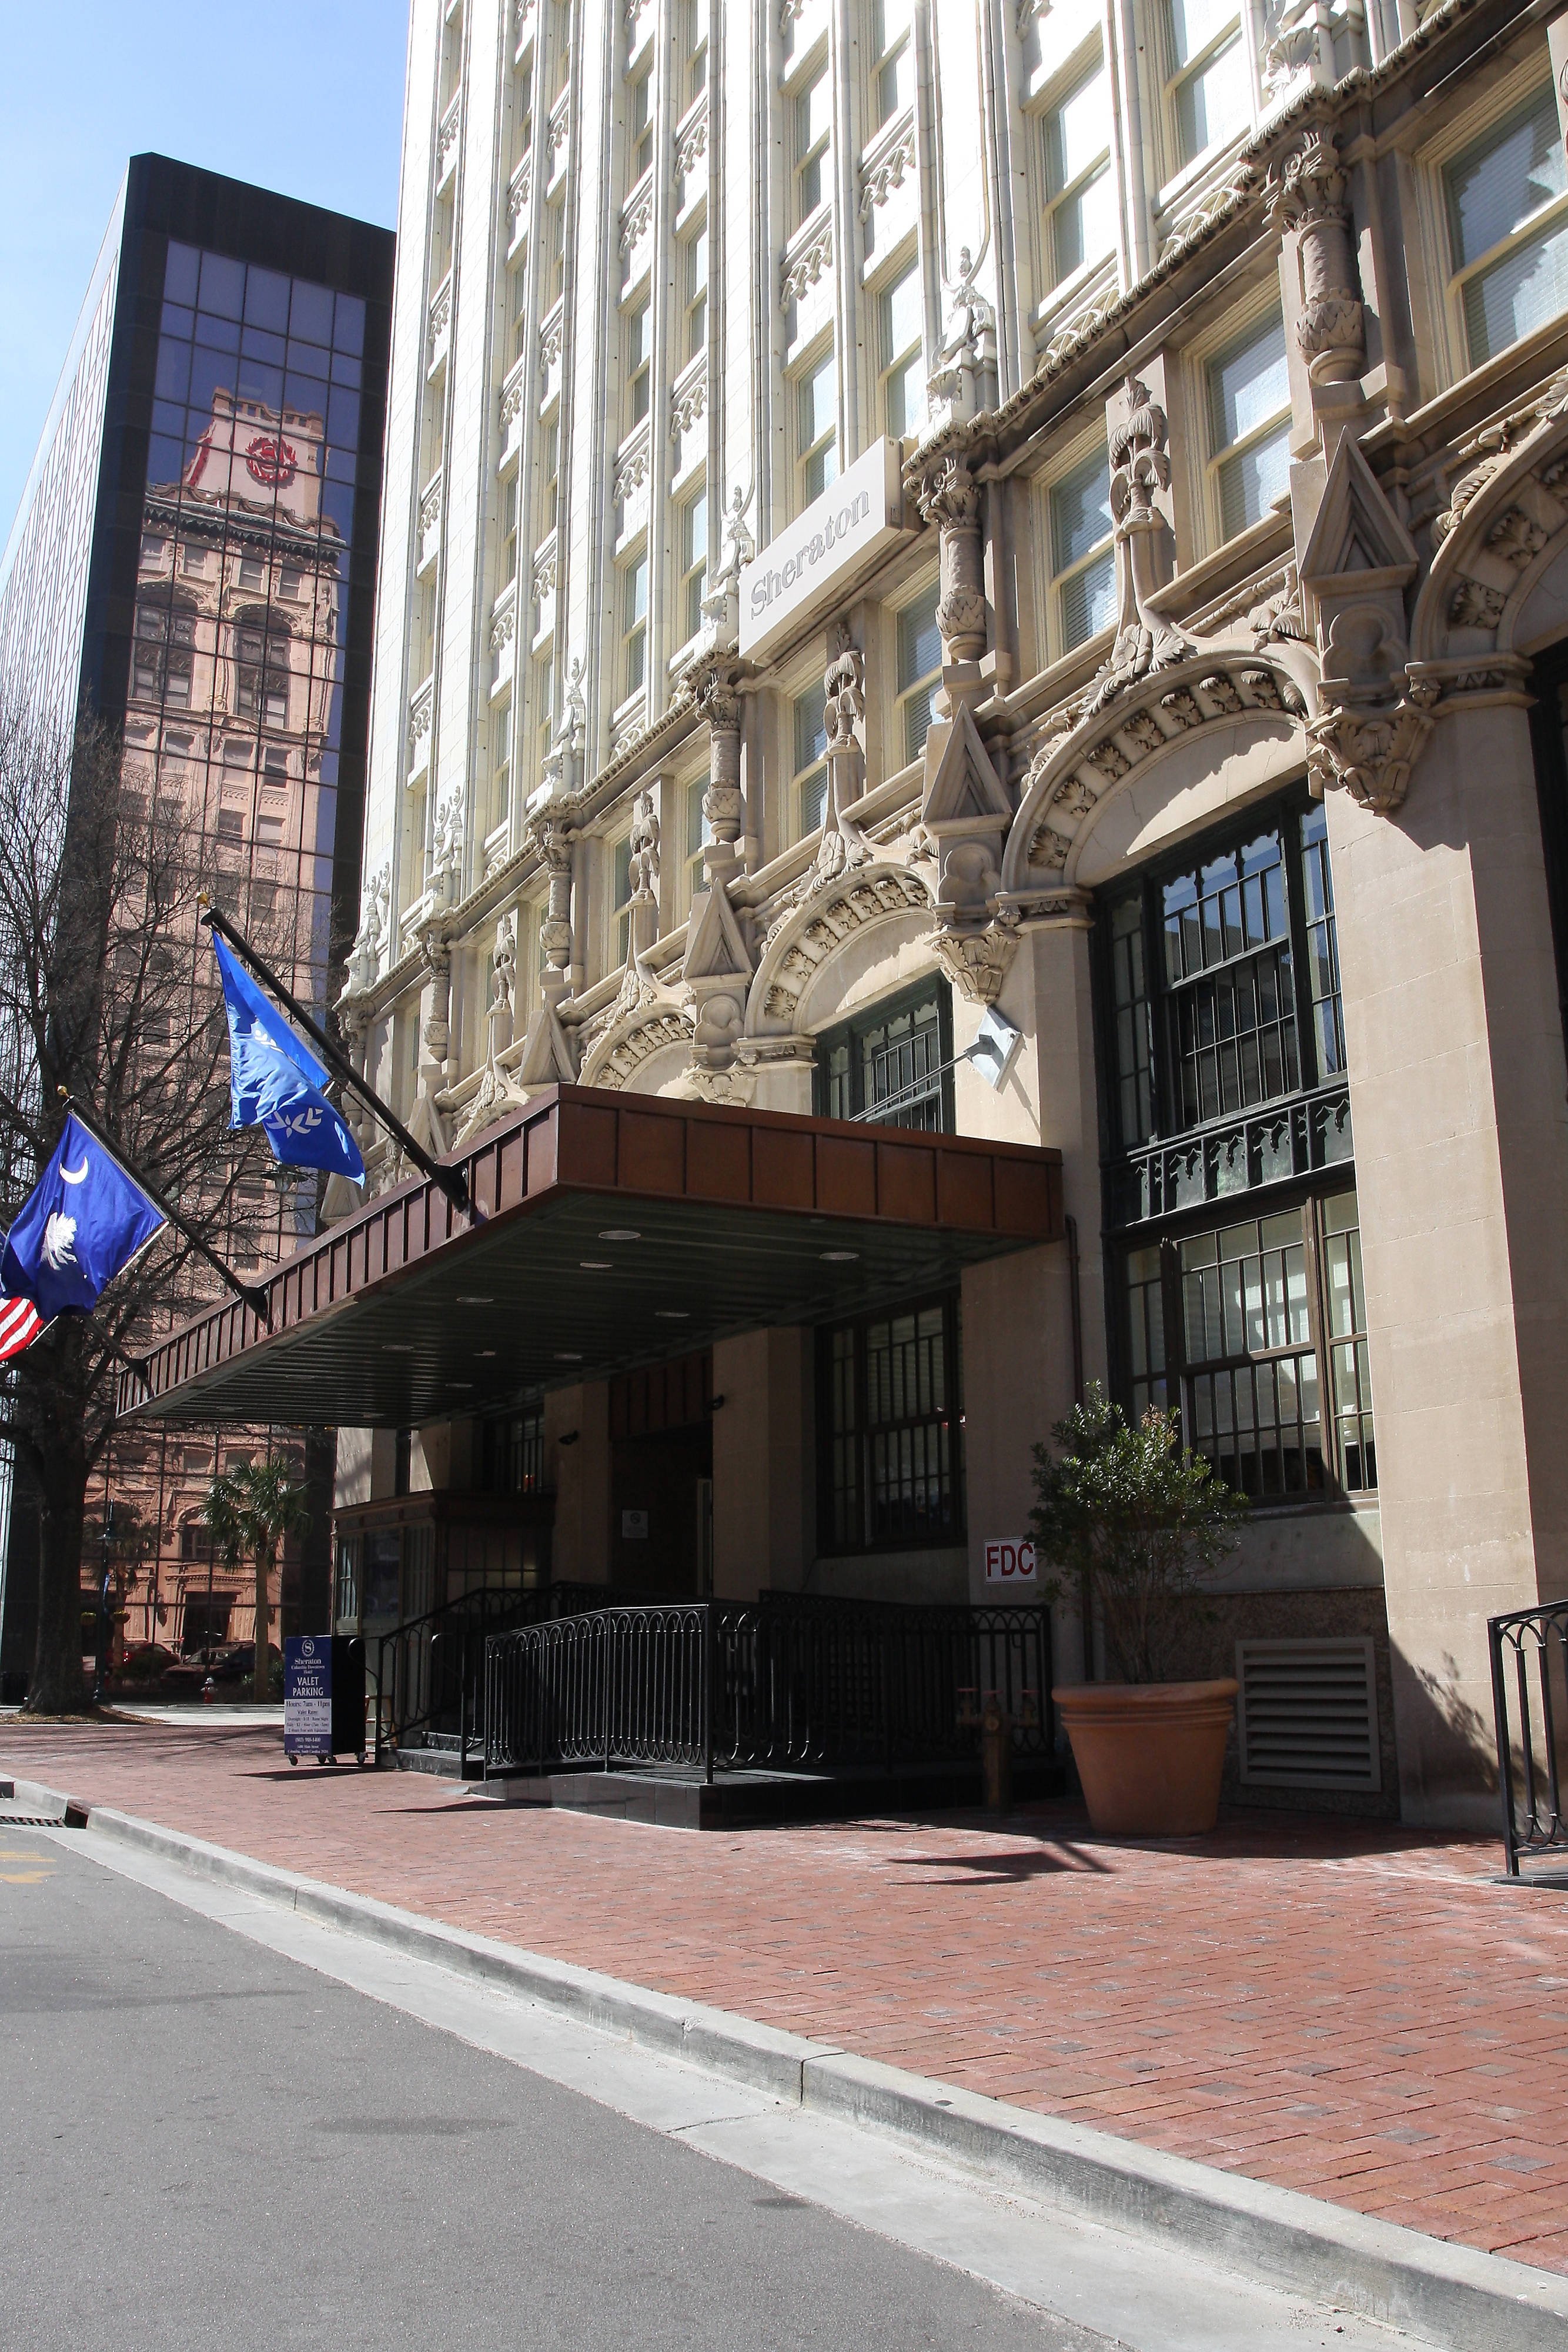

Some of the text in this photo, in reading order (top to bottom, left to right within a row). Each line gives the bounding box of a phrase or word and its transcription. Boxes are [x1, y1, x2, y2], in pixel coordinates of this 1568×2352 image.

[751, 490, 870, 620] Sheraton
[987, 1542, 1034, 1577] FDC
[293, 1687, 323, 1696] PARKING
[297, 1677, 319, 1685] VALET
